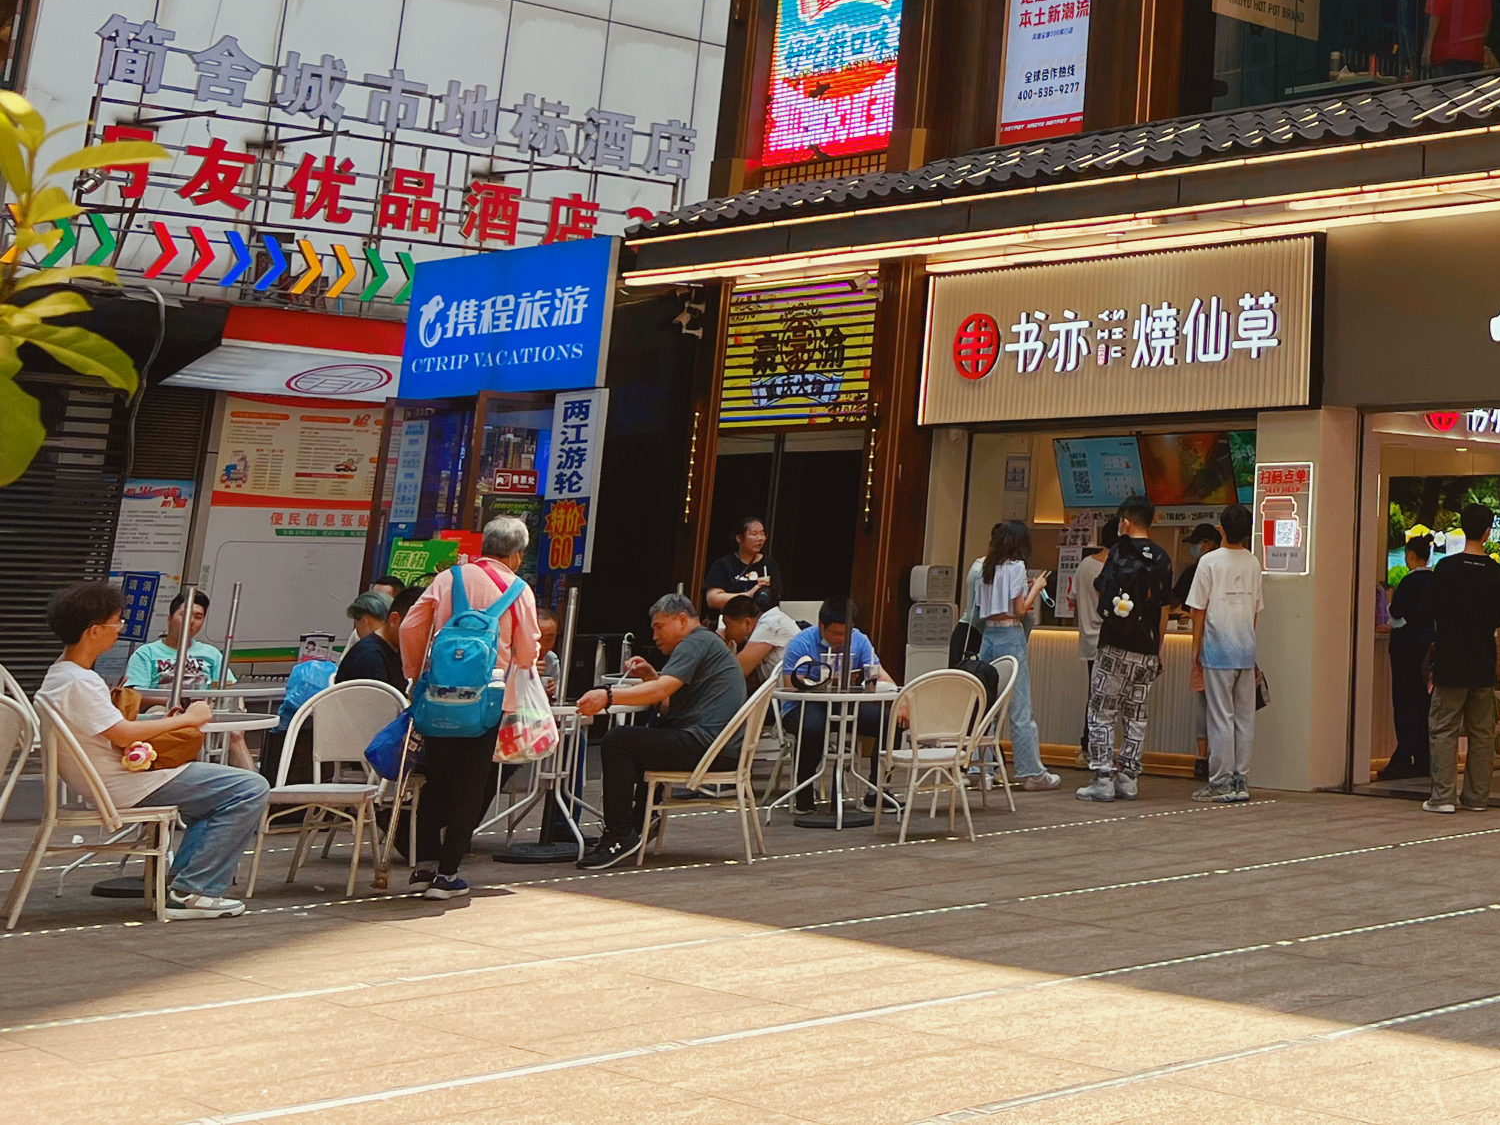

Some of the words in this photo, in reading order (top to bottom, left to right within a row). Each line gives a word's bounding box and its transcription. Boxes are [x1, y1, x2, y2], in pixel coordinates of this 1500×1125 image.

[1018, 0, 1090, 28] 本土新潮流
[1268, 2, 1281, 18] POT
[1024, 64, 1076, 84] 全球合作热线
[95, 12, 698, 179] 简舍城市地标酒店
[443, 285, 590, 339] 携程旅游
[411, 353, 469, 374] CTRIP
[473, 342, 583, 368] VACATIONS
[553, 398, 592, 495] 两江游轮
[512, 475, 536, 486] 售票处
[1261, 470, 1306, 484] 扫码点单
[549, 505, 581, 534] 特价
